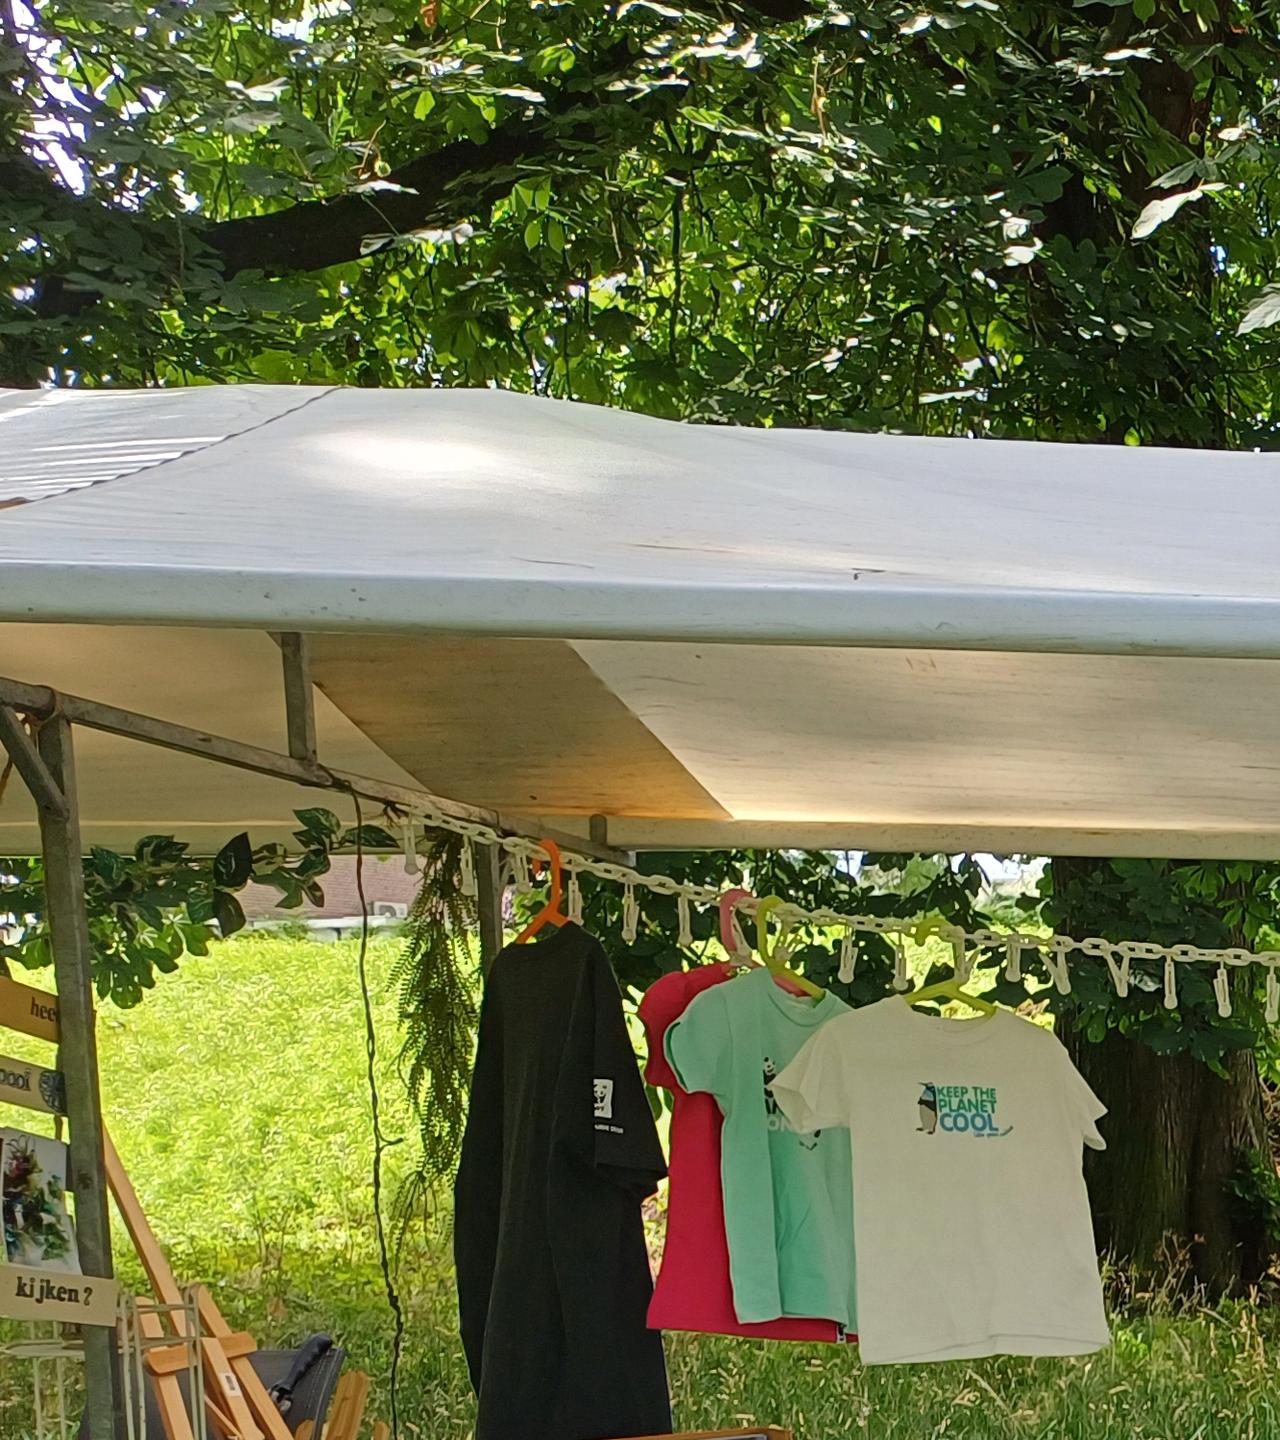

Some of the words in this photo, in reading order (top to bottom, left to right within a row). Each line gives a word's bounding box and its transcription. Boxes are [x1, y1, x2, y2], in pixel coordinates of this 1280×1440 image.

[937, 1086, 968, 1098] KEEP
[972, 1086, 996, 1100] THE
[939, 1099, 997, 1114] PLANET
[940, 1112, 999, 1132] COOL
